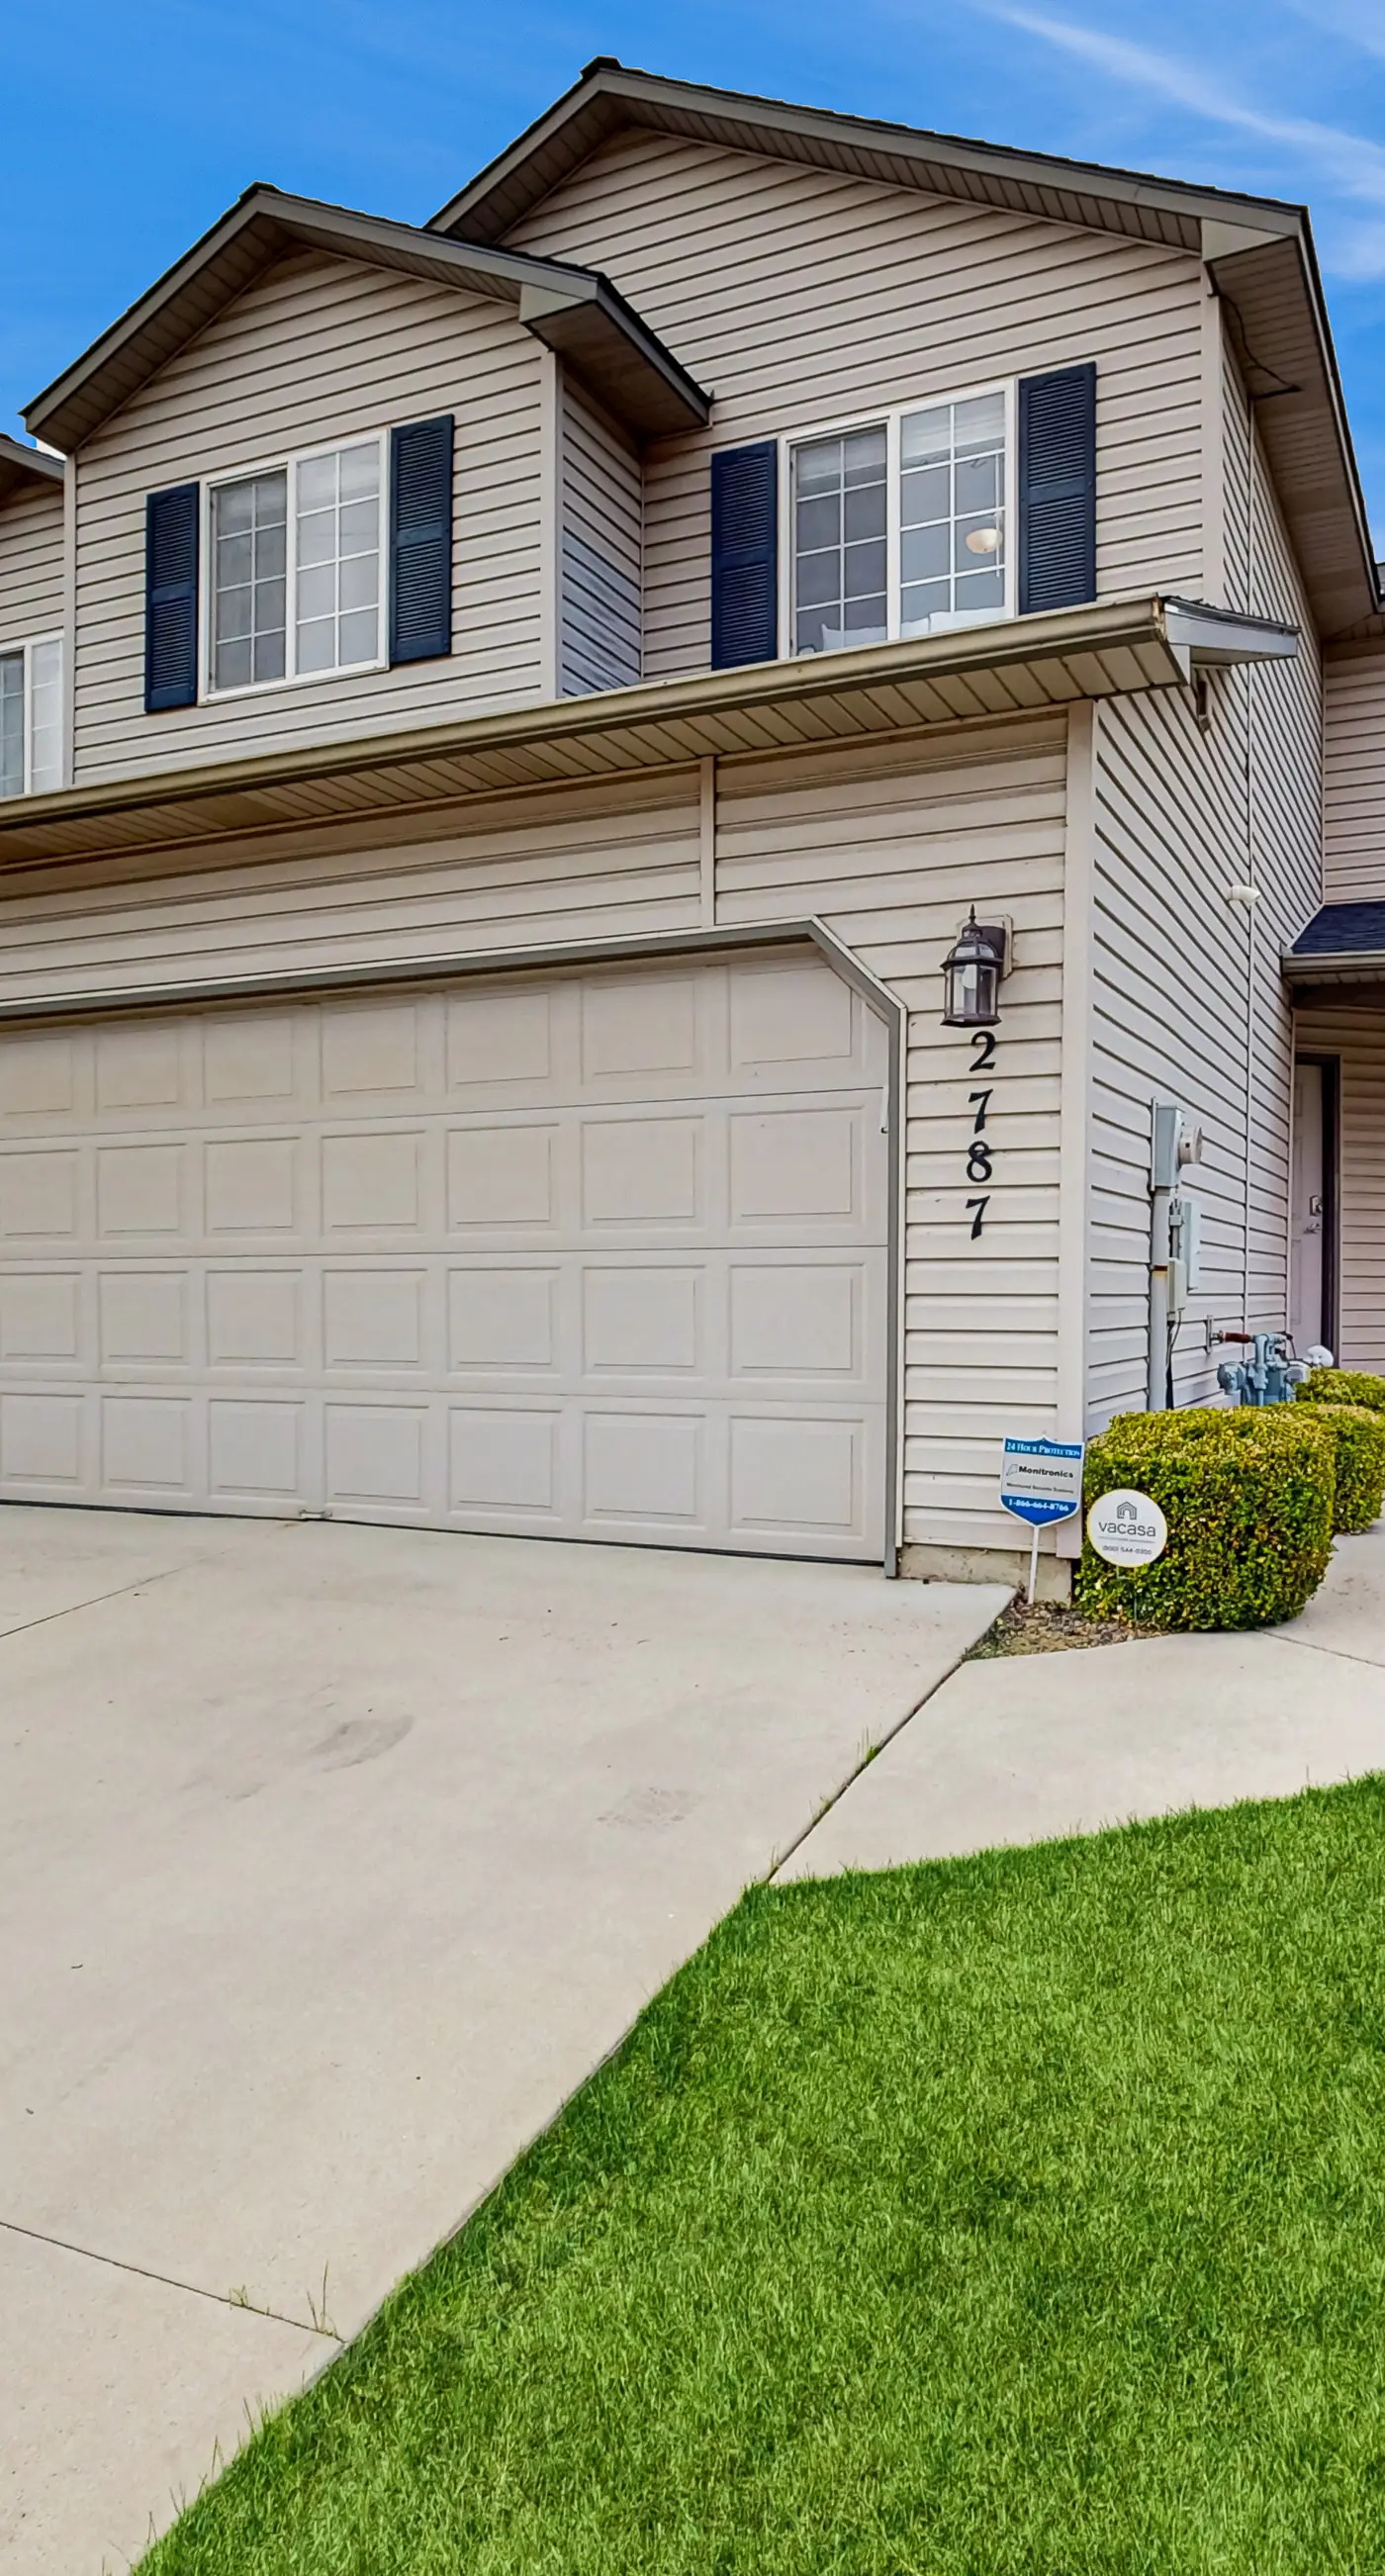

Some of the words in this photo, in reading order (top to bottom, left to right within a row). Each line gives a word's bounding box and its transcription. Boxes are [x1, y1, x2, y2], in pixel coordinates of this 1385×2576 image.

[966, 1030, 997, 1241] 2787
[1006, 1441, 1016, 1451] 24
[1018, 1466, 1073, 1479] Monitronics
[1098, 1521, 1156, 1537] vacasa
